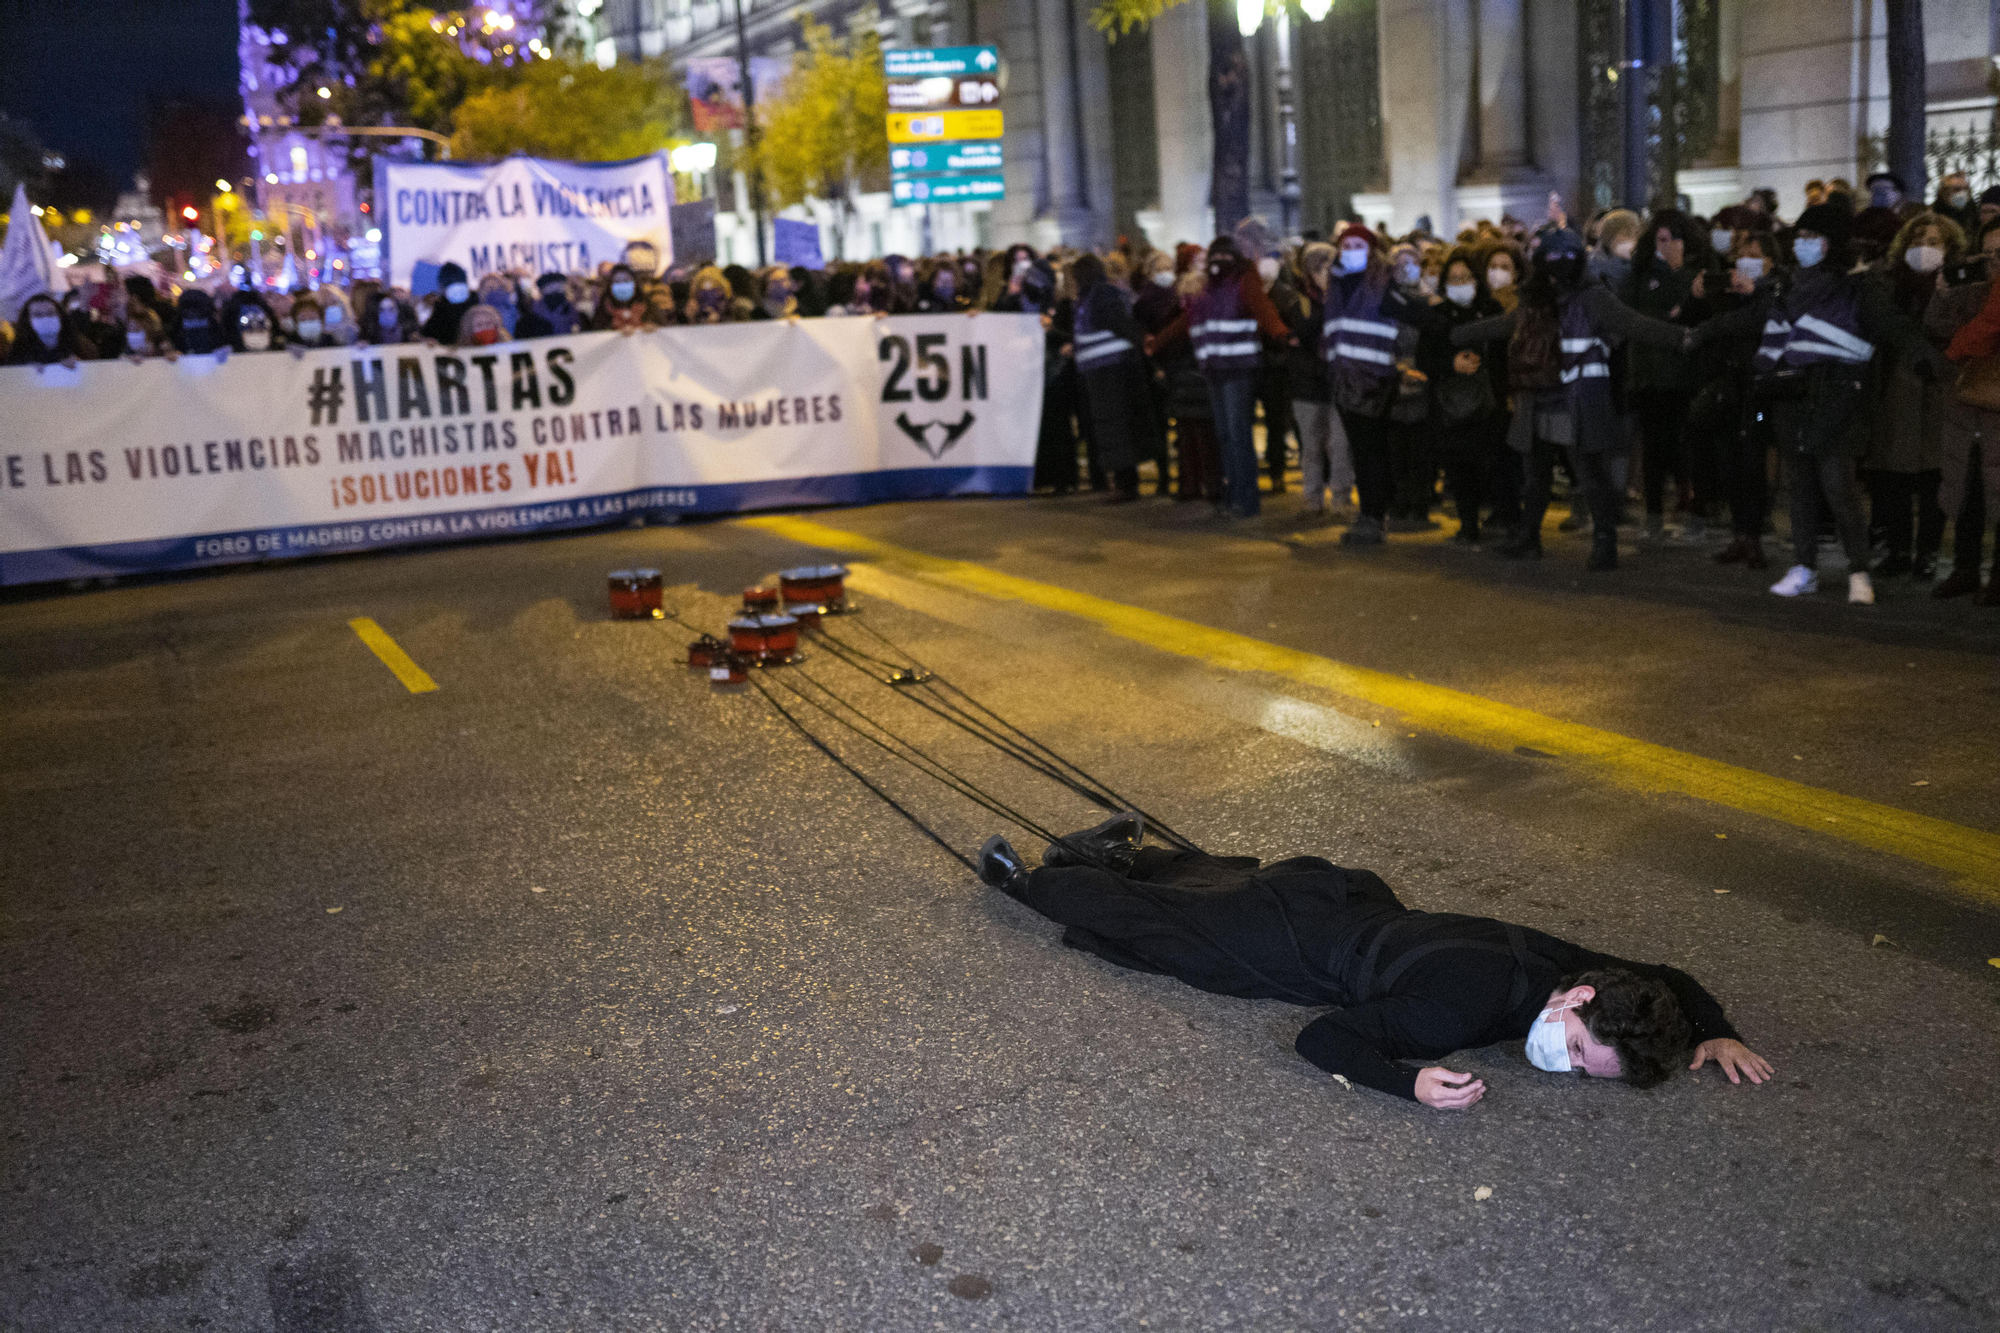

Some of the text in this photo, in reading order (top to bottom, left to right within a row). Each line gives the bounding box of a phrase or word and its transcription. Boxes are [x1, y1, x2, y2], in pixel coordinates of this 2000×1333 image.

[396, 182, 655, 226] CONTRA LA VIOLENCIA
[469, 240, 591, 278] MACHISTA
[307, 346, 576, 426] #HARTAS
[44, 451, 107, 486] LAS
[125, 436, 321, 480] VIOLENCIAS
[338, 420, 518, 462] MACHISTAS
[533, 405, 642, 444] CONTRA
[656, 399, 703, 432] LAS
[718, 395, 843, 429] MUJERES
[331, 450, 577, 509] ¡SOLUCIONES YA!
[195, 490, 697, 558] FORO DE MADRID CONTRA LA VIOLENCIA A LAS MUJERES
